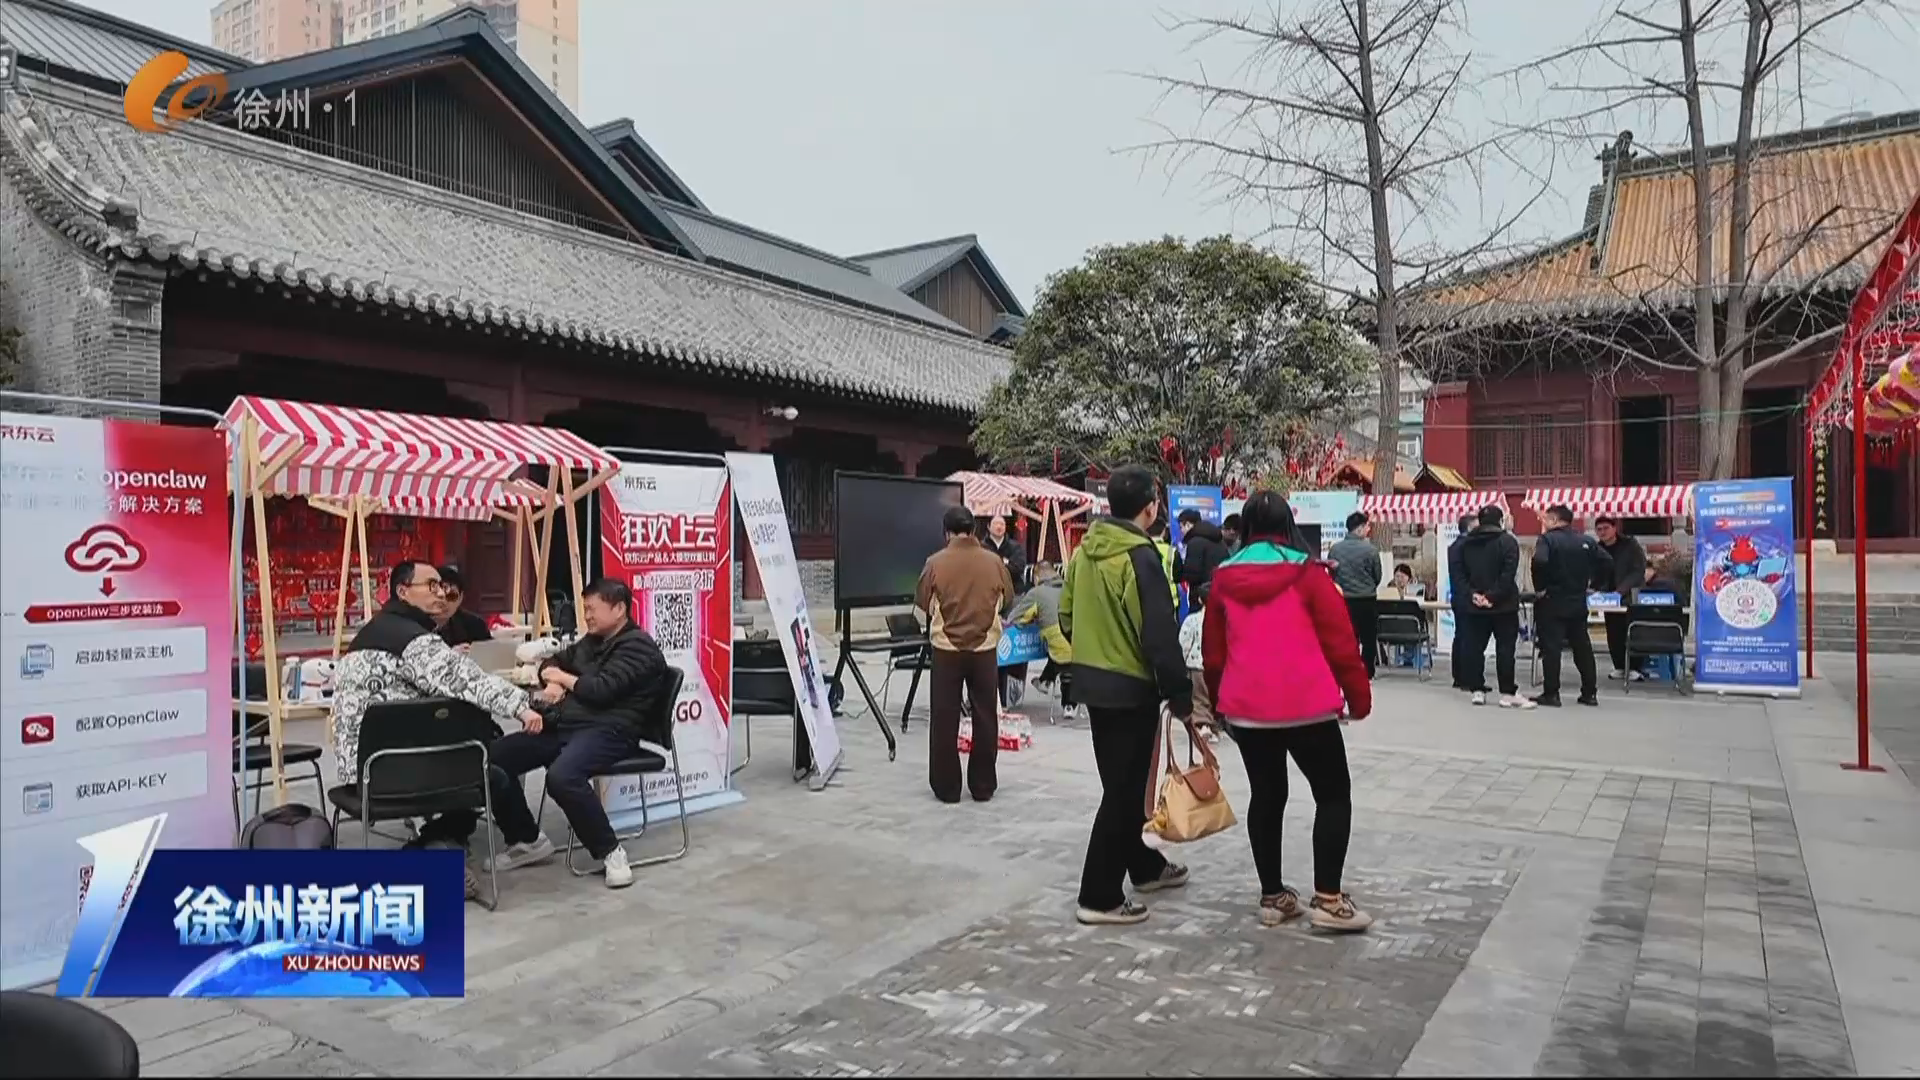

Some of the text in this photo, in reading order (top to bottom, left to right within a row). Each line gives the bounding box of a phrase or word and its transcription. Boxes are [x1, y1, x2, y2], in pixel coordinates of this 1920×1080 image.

[102, 469, 207, 490] openclaw
[621, 513, 717, 549] 狂欢上云
[47, 603, 164, 620] openclaw三步安装法
[75, 645, 174, 665] 启动轻量云主机
[76, 708, 180, 732] 配置OpenClaw
[76, 773, 168, 800] 获取API-KEY
